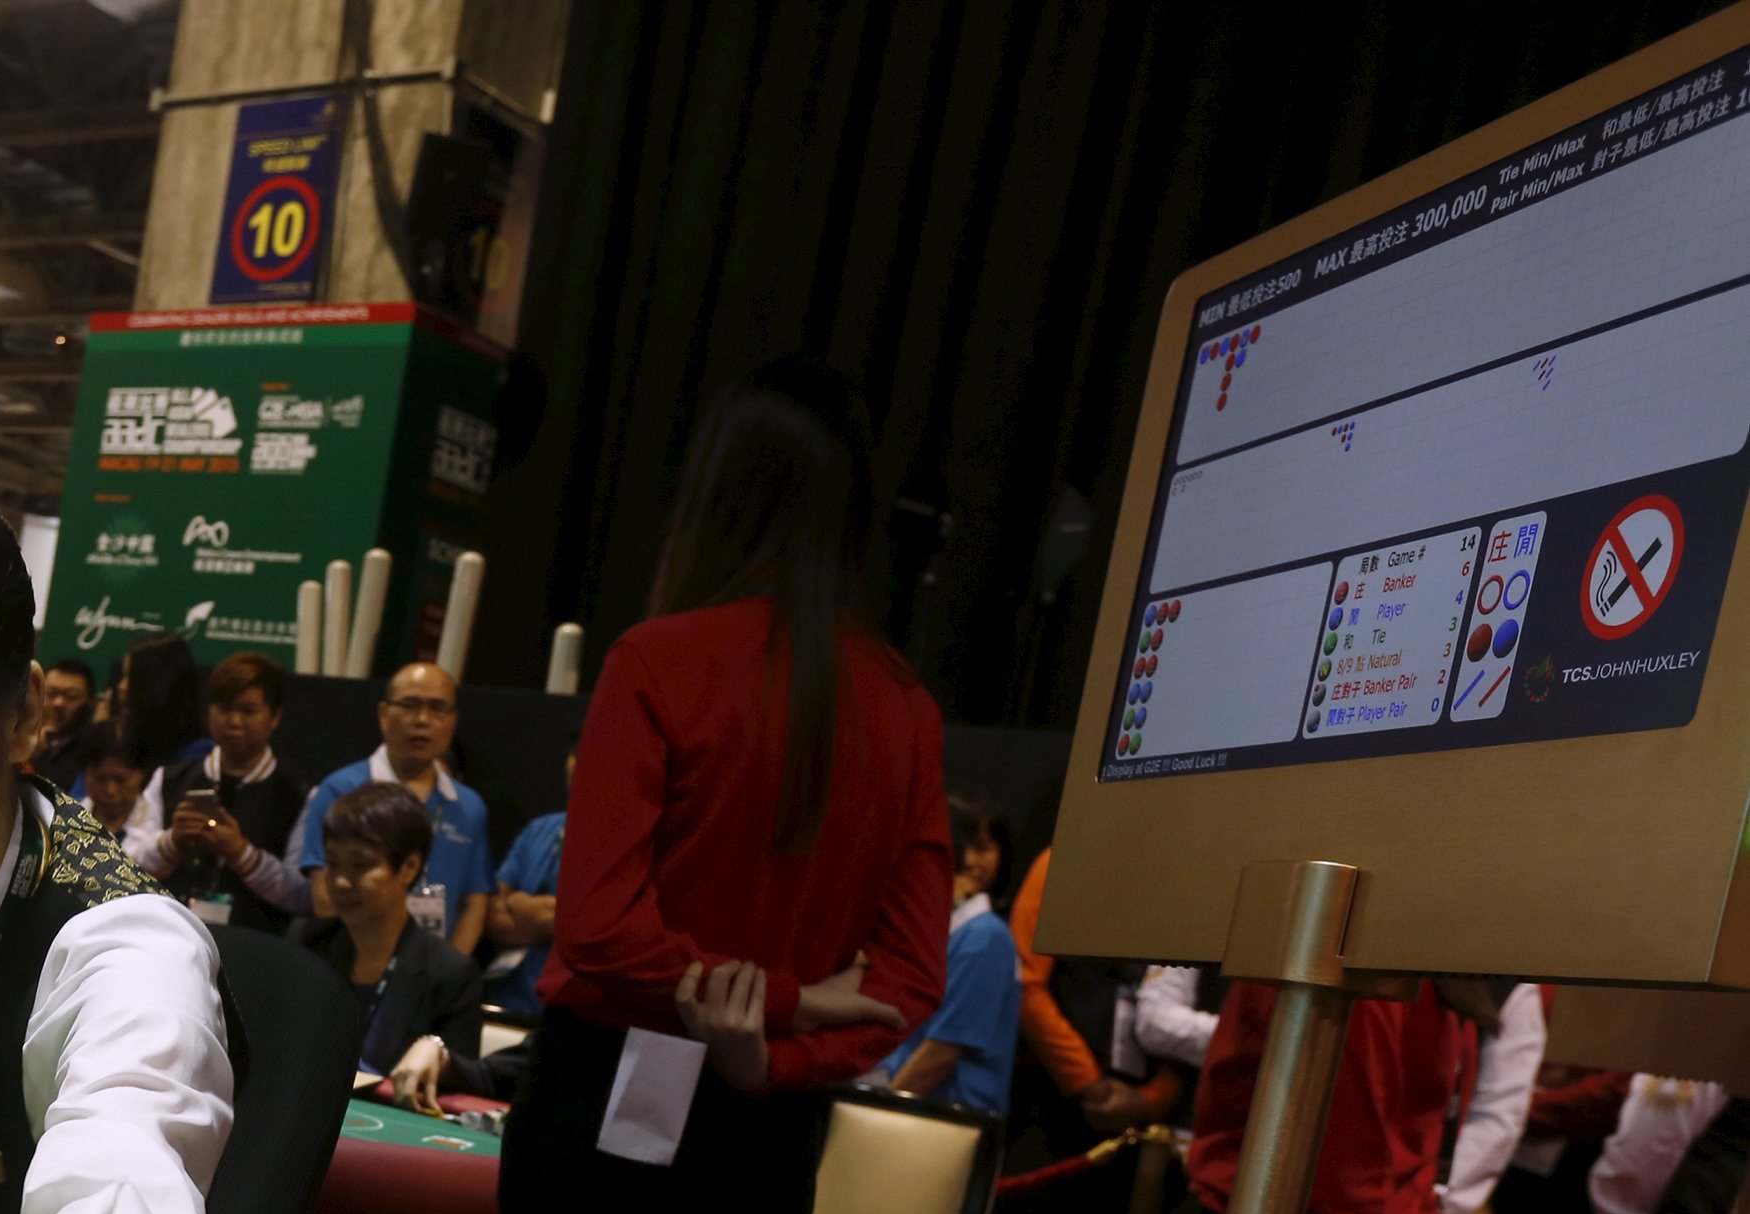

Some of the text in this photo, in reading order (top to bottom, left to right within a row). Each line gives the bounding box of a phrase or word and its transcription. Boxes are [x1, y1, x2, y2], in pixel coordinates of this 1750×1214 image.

[1499, 168, 1519, 186] Tie
[1522, 134, 1587, 175] Min/Max
[1490, 192, 1519, 214] Pair
[1520, 161, 1585, 203] Min/Max
[249, 201, 306, 258] 10
[1198, 300, 1227, 328] MIN
[1314, 246, 1349, 280] MAX
[1410, 184, 1488, 239] 300,000
[1387, 549, 1415, 568] Game
[1417, 545, 1426, 562] #
[1460, 534, 1477, 552] 14
[1487, 530, 1512, 563] 庄
[1382, 573, 1417, 594] Banker
[1461, 561, 1471, 577] 6
[1376, 601, 1406, 622] Player
[1454, 590, 1464, 605] 4
[1372, 629, 1386, 646] Tie
[1449, 617, 1458, 632] 3
[1367, 649, 1403, 670] Natural
[1442, 643, 1452, 658] 3
[1562, 650, 1701, 684] TCSJOHNHUXLEY
[1363, 677, 1396, 697] Banker
[1397, 674, 1418, 692] Pair
[1437, 669, 1446, 685] 2
[1357, 706, 1386, 724] Player
[1387, 702, 1408, 719] Pair
[1430, 698, 1440, 713] 0
[1171, 757, 1194, 771] Good
[1195, 754, 1216, 769] Luck
